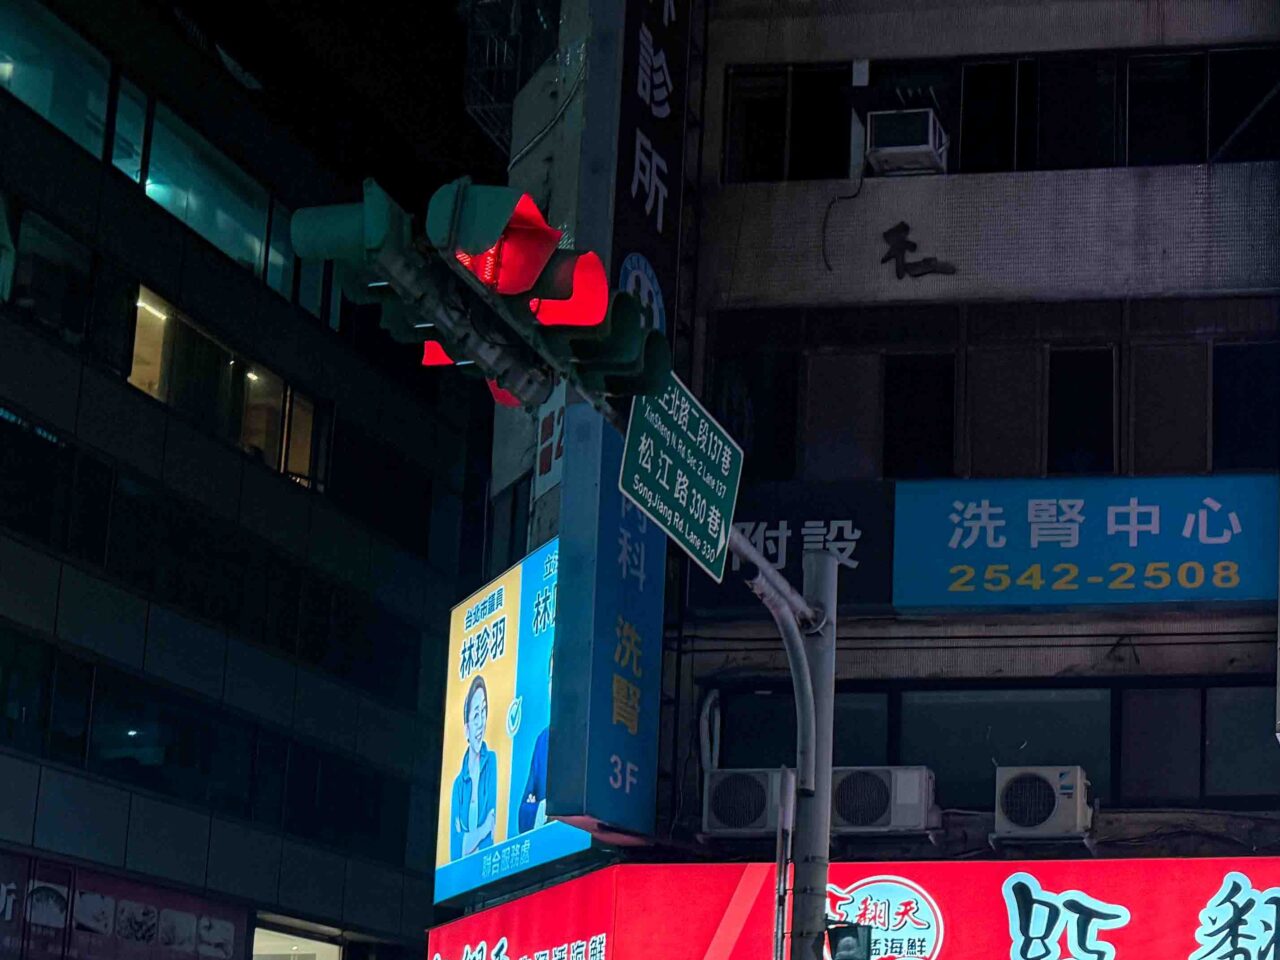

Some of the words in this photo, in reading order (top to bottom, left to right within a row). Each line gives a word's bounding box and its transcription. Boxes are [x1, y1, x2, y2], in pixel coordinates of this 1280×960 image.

[642, 386, 732, 476] 北路二段137巷
[685, 524, 702, 549] Lane
[702, 540, 717, 563] 330
[947, 497, 1243, 550] 洗腎中心
[947, 561, 1242, 592] 2542-2508
[460, 619, 506, 677] 林珍羽
[609, 755, 639, 794] 3F
